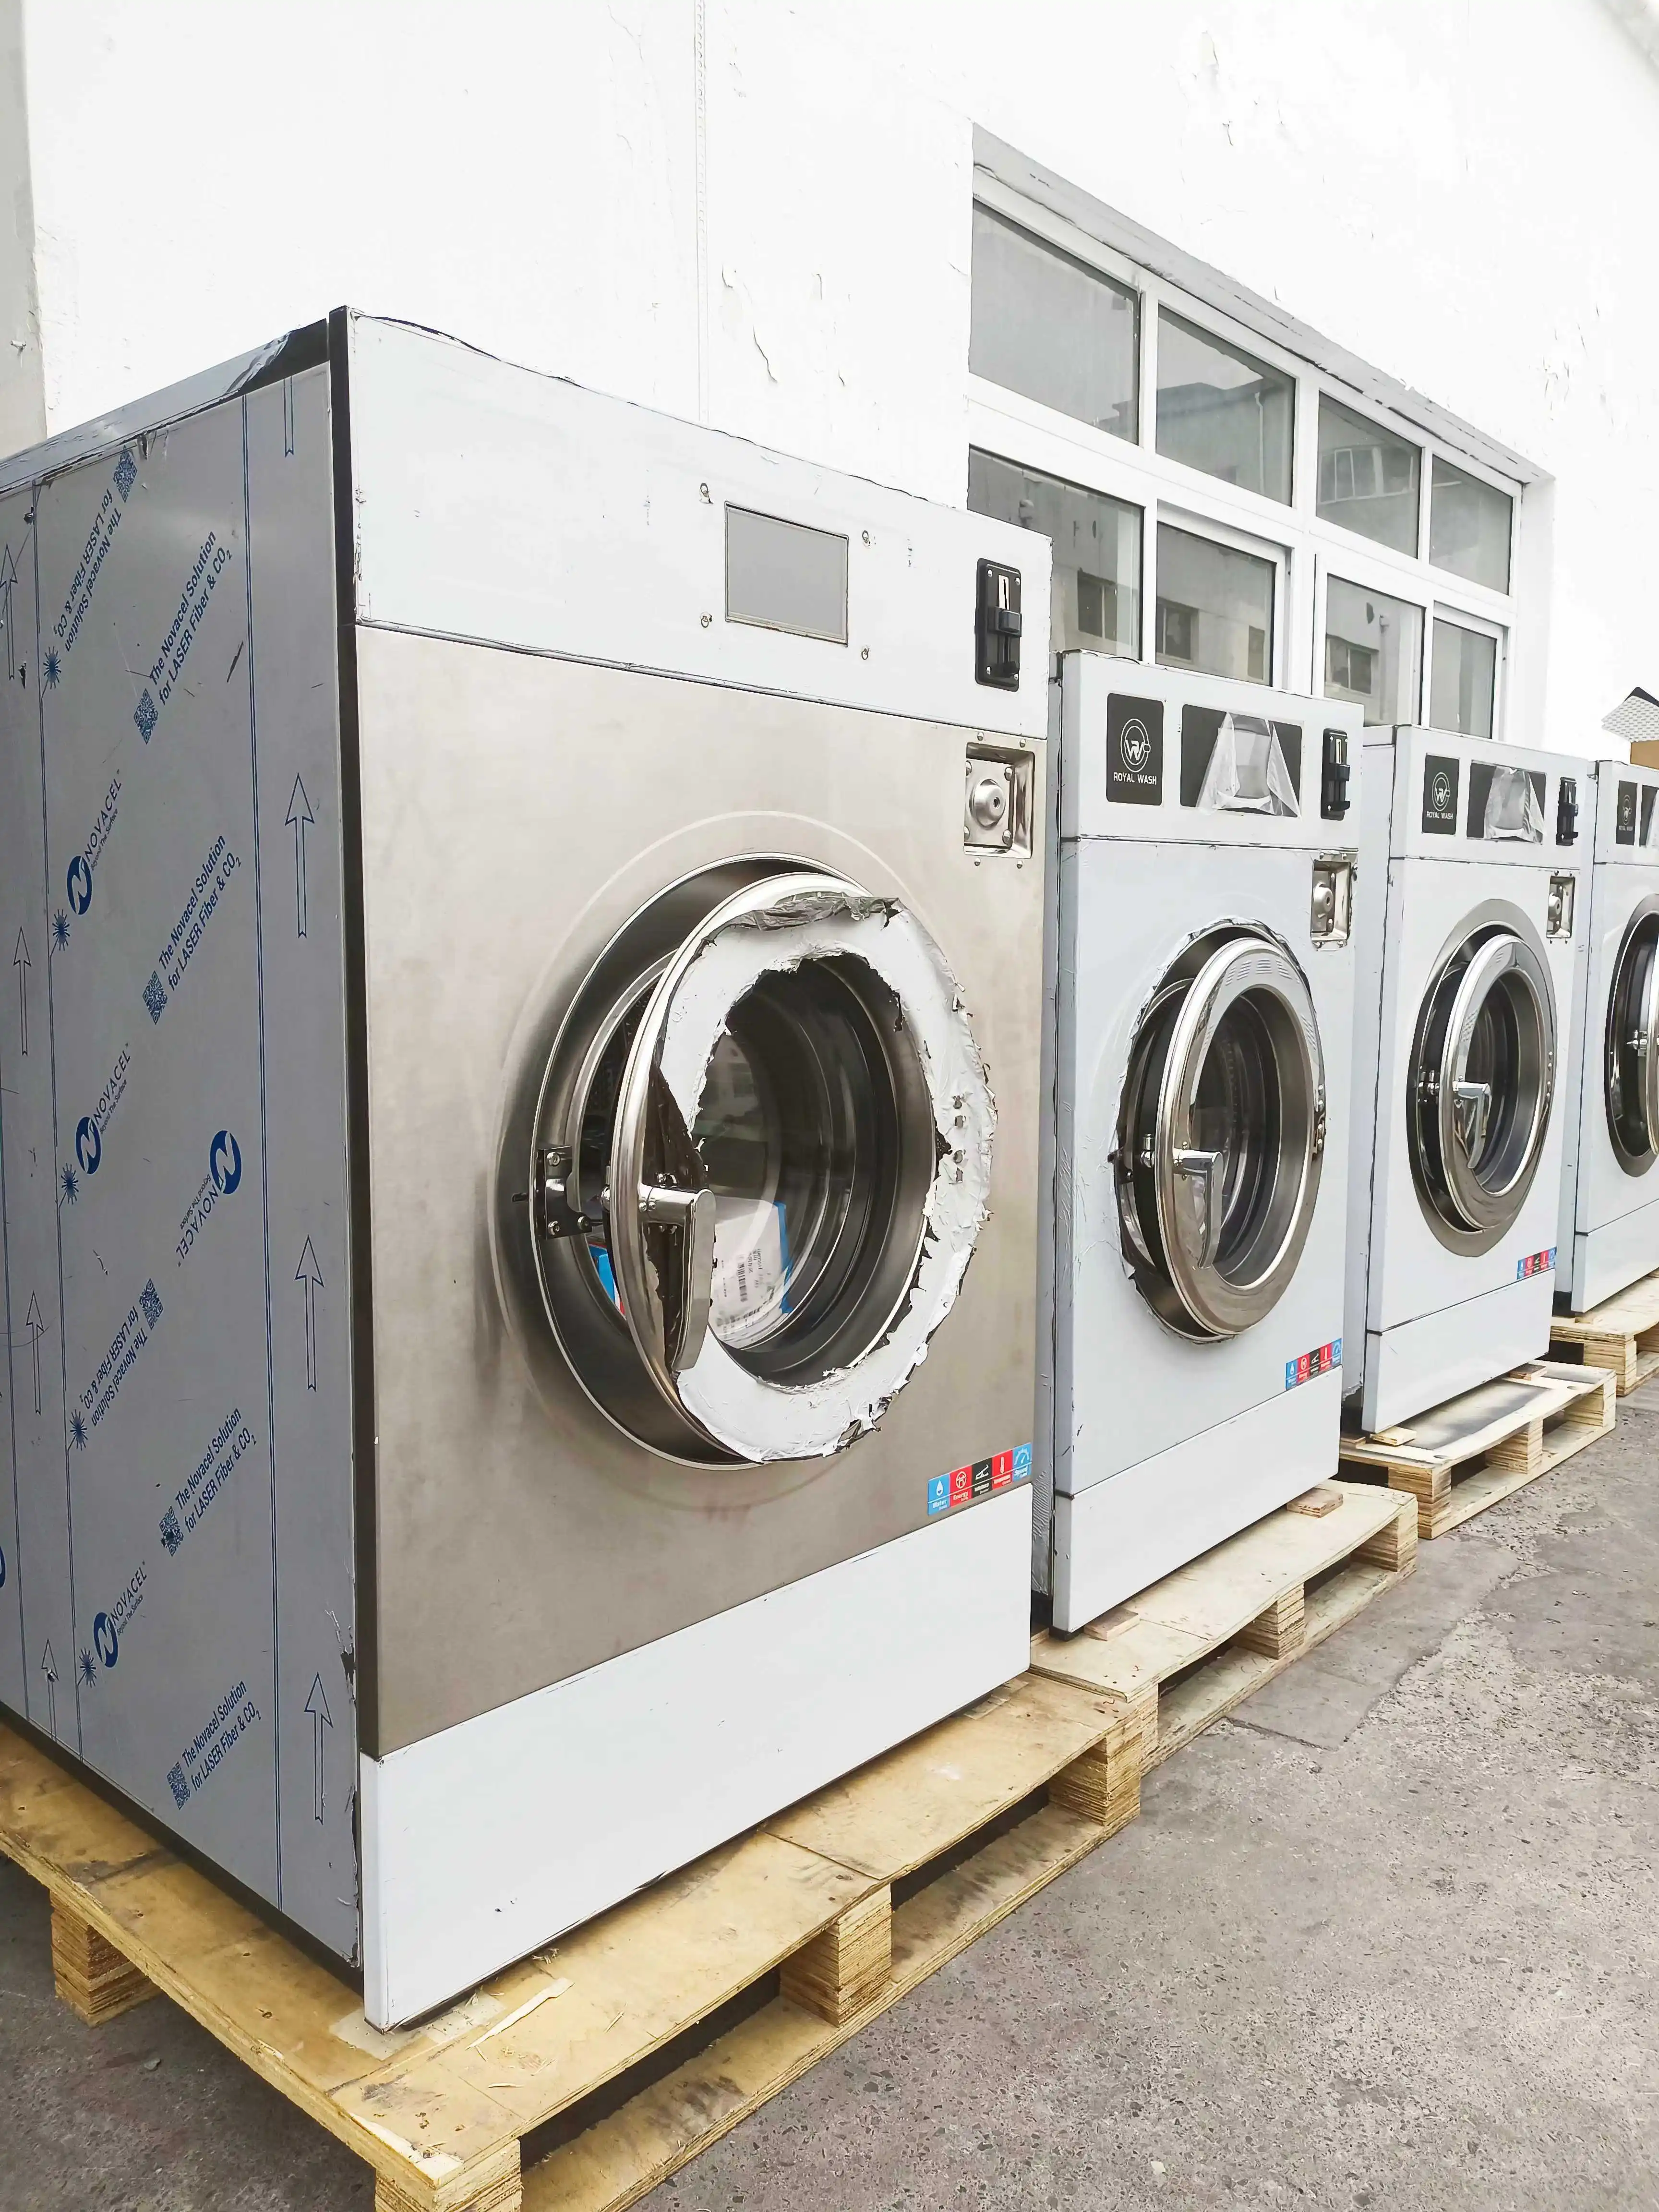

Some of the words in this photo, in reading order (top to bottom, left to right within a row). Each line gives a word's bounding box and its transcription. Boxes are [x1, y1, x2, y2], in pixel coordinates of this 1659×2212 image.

[101, 489, 114, 514] for
[107, 508, 121, 535] The
[83, 512, 104, 564] LASER
[70, 562, 86, 601] Fiber
[86, 535, 111, 598] Novacel
[64, 600, 72, 614] &
[65, 593, 89, 652] Solution
[150, 657, 164, 685] The
[161, 593, 189, 658] Novacel
[186, 531, 216, 597] Solution
[159, 679, 171, 705] for
[168, 628, 192, 682] LASER
[189, 588, 209, 632] Fiber
[206, 574, 216, 590] &
[1113, 772, 1135, 783] ROYAL
[1137, 774, 1157, 785] WASH
[84, 779, 121, 862] NOVACEL
[159, 944, 174, 970] The
[170, 887, 198, 947] Novacel
[195, 835, 226, 893] Solution
[168, 967, 180, 991] for
[177, 923, 203, 972] LASER
[199, 888, 219, 928] Fiber
[216, 876, 226, 891] &
[94, 1050, 130, 1125] NOVACEL
[176, 1184, 218, 1259] NOVACEL
[109, 1322, 131, 1361] LASER
[127, 1305, 139, 1327] for
[134, 1327, 148, 1350] The
[91, 1380, 98, 1394] &
[96, 1355, 112, 1384] Fiber
[113, 1346, 136, 1393] Novacel
[91, 1385, 115, 1427] Solution
[175, 1488, 190, 1510] The
[187, 1444, 215, 1491] Novacel
[212, 1408, 241, 1454] Solution
[184, 1512, 197, 1533] for
[194, 1479, 218, 1519] LASER
[215, 1455, 234, 1487] Fiber
[232, 1444, 241, 1460] &
[932, 1499, 947, 1508] Water
[953, 1491, 968, 1501] Energy
[110, 1567, 147, 1626] NOVACEL
[182, 1747, 196, 1768] The
[193, 1710, 220, 1754] Novacel
[217, 1681, 247, 1721] Solution
[191, 1772, 203, 1791] for
[200, 1743, 224, 1780] LASER
[220, 1724, 240, 1754] Fiber
[237, 1715, 246, 1731] &
